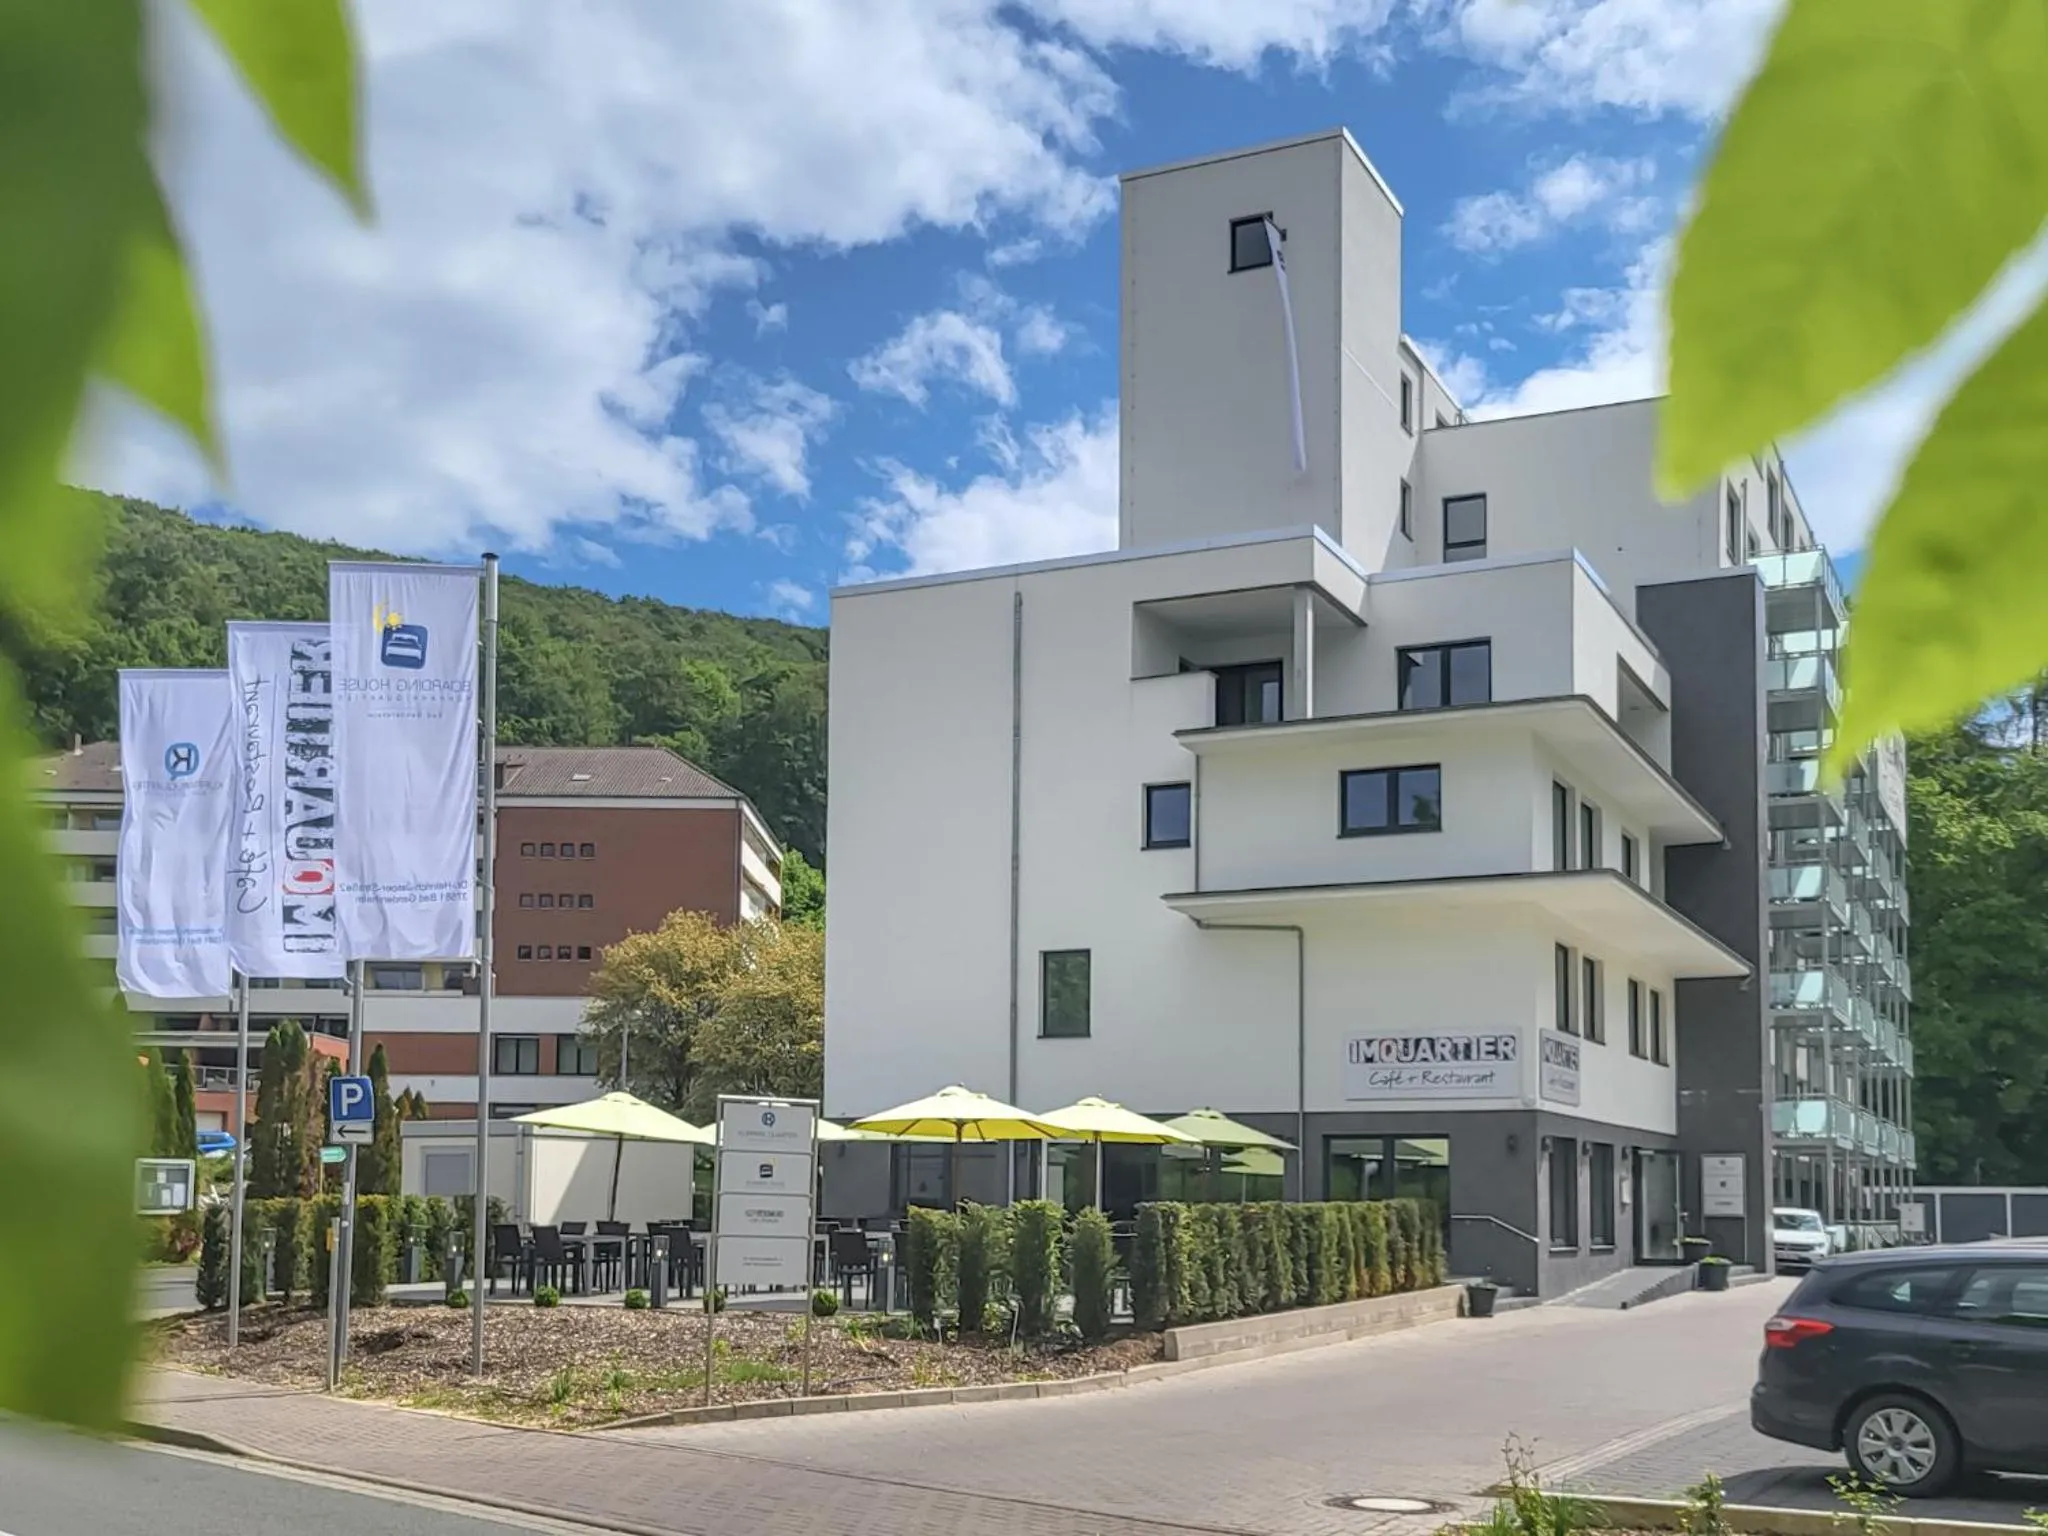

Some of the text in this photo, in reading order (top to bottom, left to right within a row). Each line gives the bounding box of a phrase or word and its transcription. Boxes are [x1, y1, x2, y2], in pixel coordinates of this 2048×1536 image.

[1349, 1035, 1517, 1064] IMQUARTIER
[1369, 1070, 1403, 1089] Café
[1421, 1070, 1496, 1085] Restaurant
[341, 1083, 363, 1116] P
